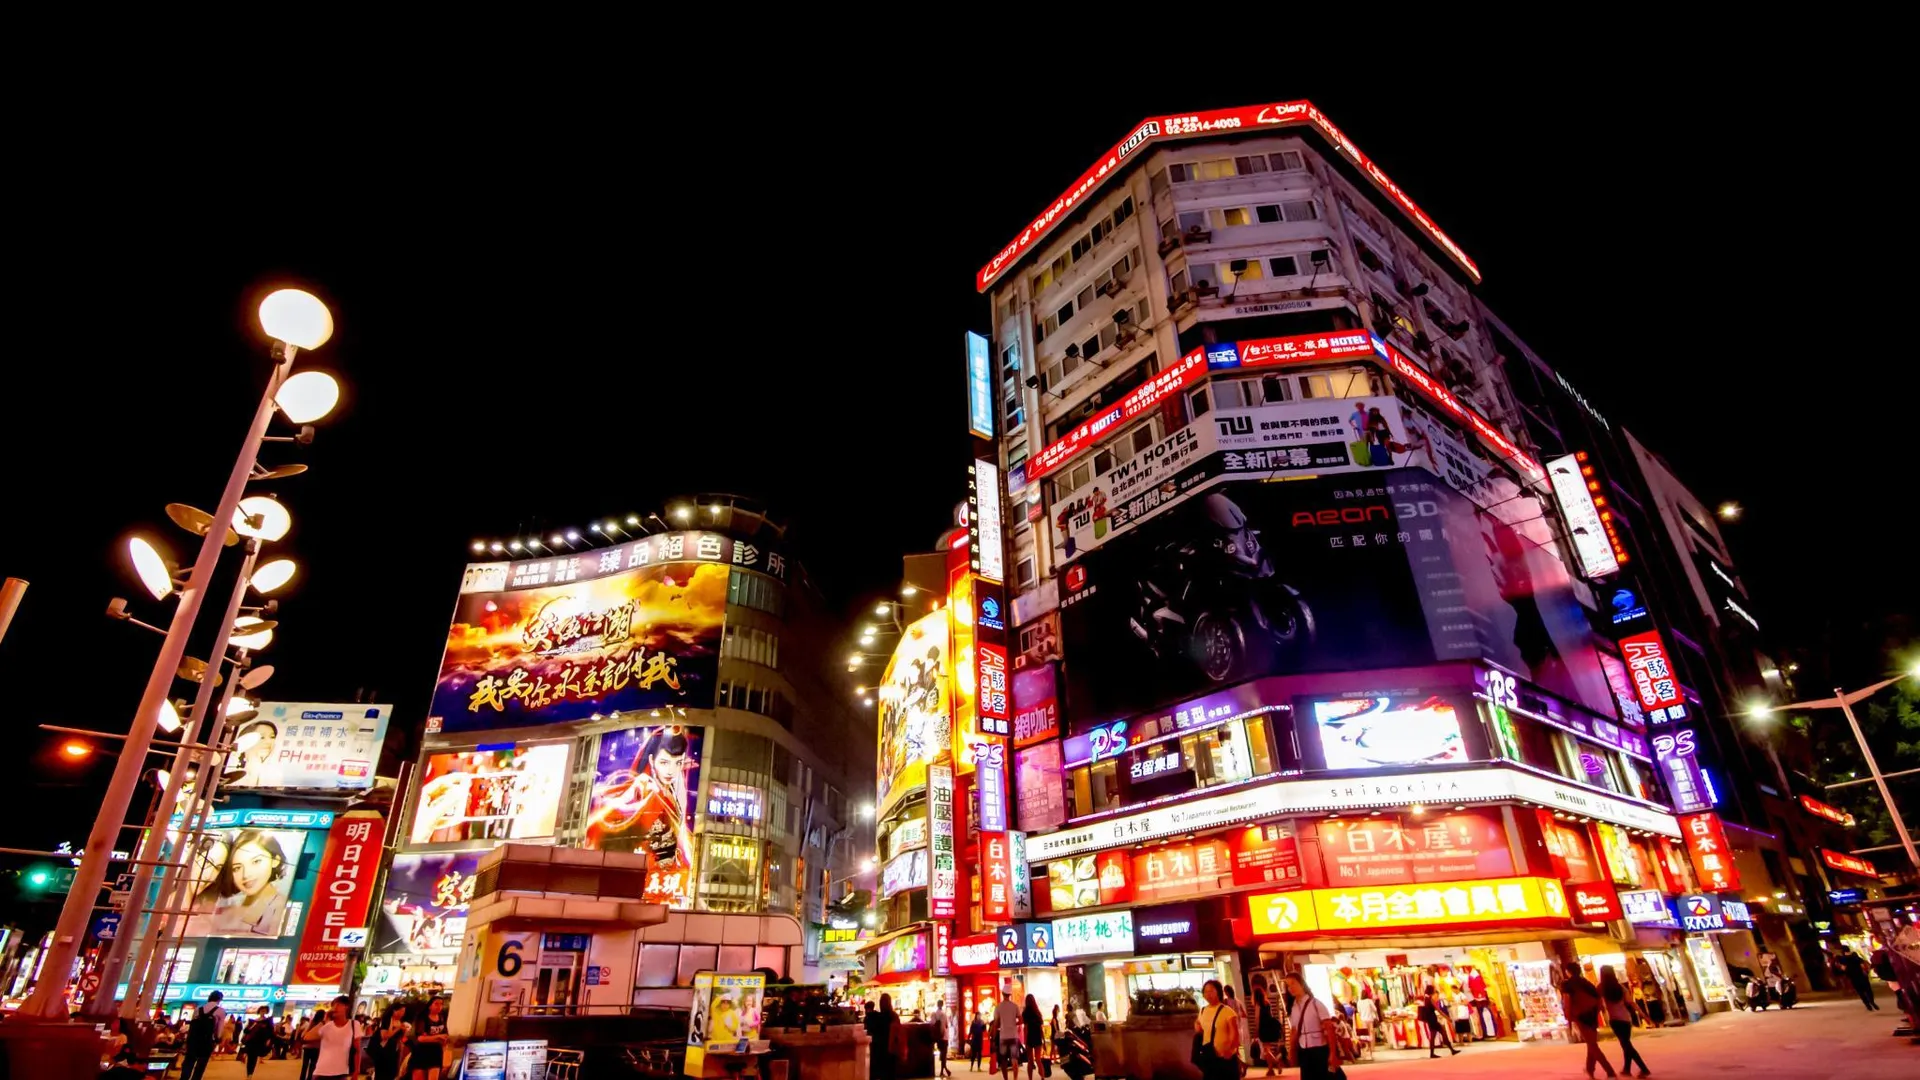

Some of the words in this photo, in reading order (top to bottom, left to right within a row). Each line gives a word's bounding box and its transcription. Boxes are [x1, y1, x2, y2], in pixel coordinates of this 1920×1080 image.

[1275, 104, 1306, 115] Diary
[993, 241, 1017, 269] Diary
[1020, 231, 1030, 245] of
[1033, 199, 1064, 232] Taipei
[1120, 123, 1157, 156] HOTEL
[1331, 335, 1366, 346] HOTEL
[1091, 410, 1122, 435] HOTEL
[1108, 455, 1139, 484] TW1
[1143, 427, 1197, 466] HOTEL
[1395, 501, 1440, 518] 3D
[599, 535, 786, 579] 臻品絕色診所
[468, 647, 681, 713] 我要你永遠記得我
[1485, 671, 1518, 708] PS
[1647, 659, 1676, 702] 駭客
[1015, 708, 1047, 741] 網咖
[1650, 704, 1686, 725] 網咖
[285, 725, 348, 738] 瞬間補水
[1090, 721, 1127, 763] PS
[1653, 730, 1695, 761] PS
[278, 750, 303, 763] PH
[1130, 752, 1179, 778] 名留集團
[1114, 818, 1152, 838] 白木屋
[1186, 809, 1212, 821] Japanese
[1347, 823, 1454, 854] 白木屋
[1690, 818, 1723, 871] 白木屋
[989, 838, 1006, 903] 白木屋
[1146, 846, 1221, 882] 白木屋
[1340, 864, 1361, 877] No.1
[497, 940, 524, 977] 6
